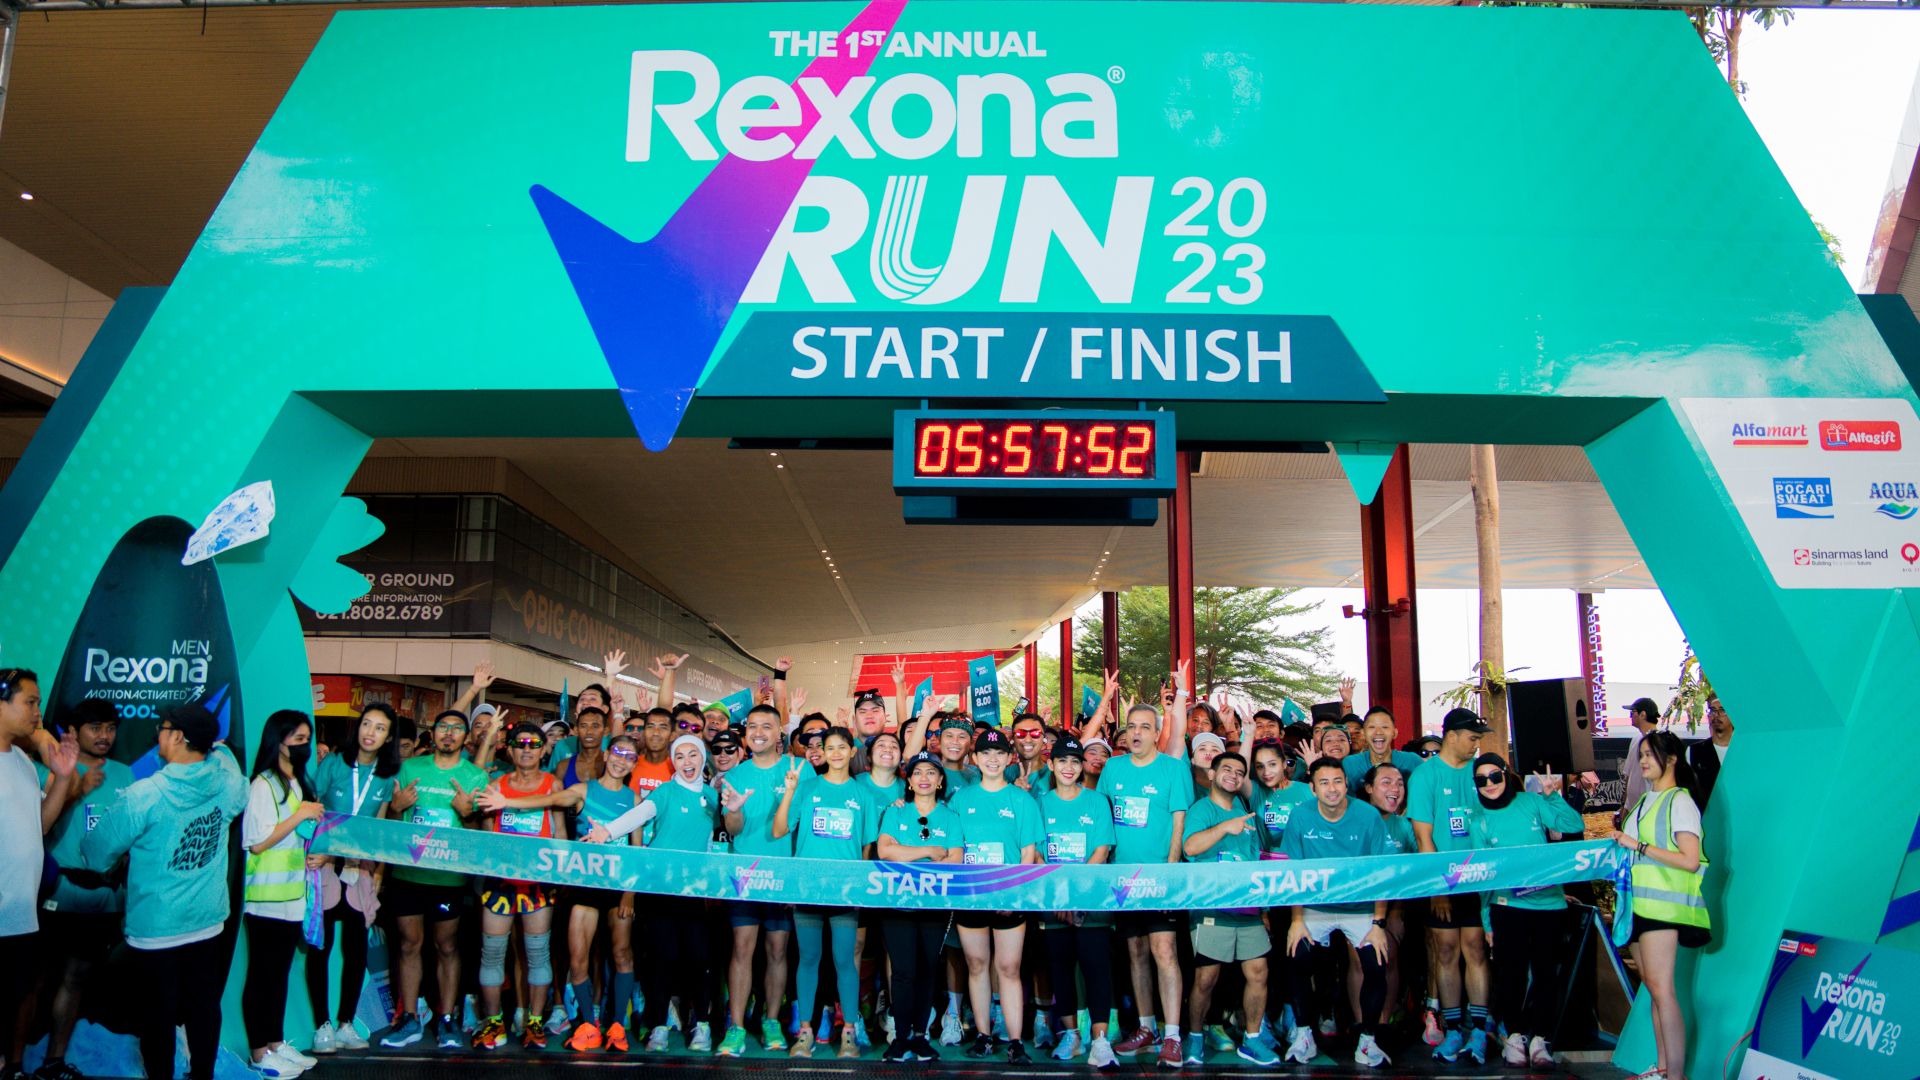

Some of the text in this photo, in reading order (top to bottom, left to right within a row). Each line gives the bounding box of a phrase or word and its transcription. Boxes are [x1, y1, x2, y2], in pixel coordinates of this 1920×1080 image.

[769, 30, 1047, 58] THE 1ST ANNUAL
[1165, 176, 1267, 238] 20
[739, 175, 1155, 304] RUN
[1165, 243, 1267, 305] 23
[791, 326, 1292, 383] START / FINISH
[1732, 423, 1807, 438] Alfamart
[1848, 430, 1896, 445] Alfagift
[917, 424, 1152, 474] 05:57:52
[1775, 484, 1830, 494] POCARI
[1869, 482, 1919, 502] AQUA
[1777, 494, 1826, 504] SWEAT
[1811, 549, 1888, 559] sinarmas land
[380, 573, 455, 587] GROUND
[372, 594, 443, 603] INFORMATION
[172, 639, 210, 655] MEN
[974, 683, 992, 697] PACE
[976, 696, 992, 707] 8.00
[537, 848, 621, 878] START
[866, 871, 953, 897] START
[1249, 868, 1335, 896] START
[1814, 971, 1886, 1016] Rexona
[1820, 1007, 1885, 1051] RUN
[1882, 1022, 1901, 1040] 20
[1878, 1039, 1897, 1056] 23
